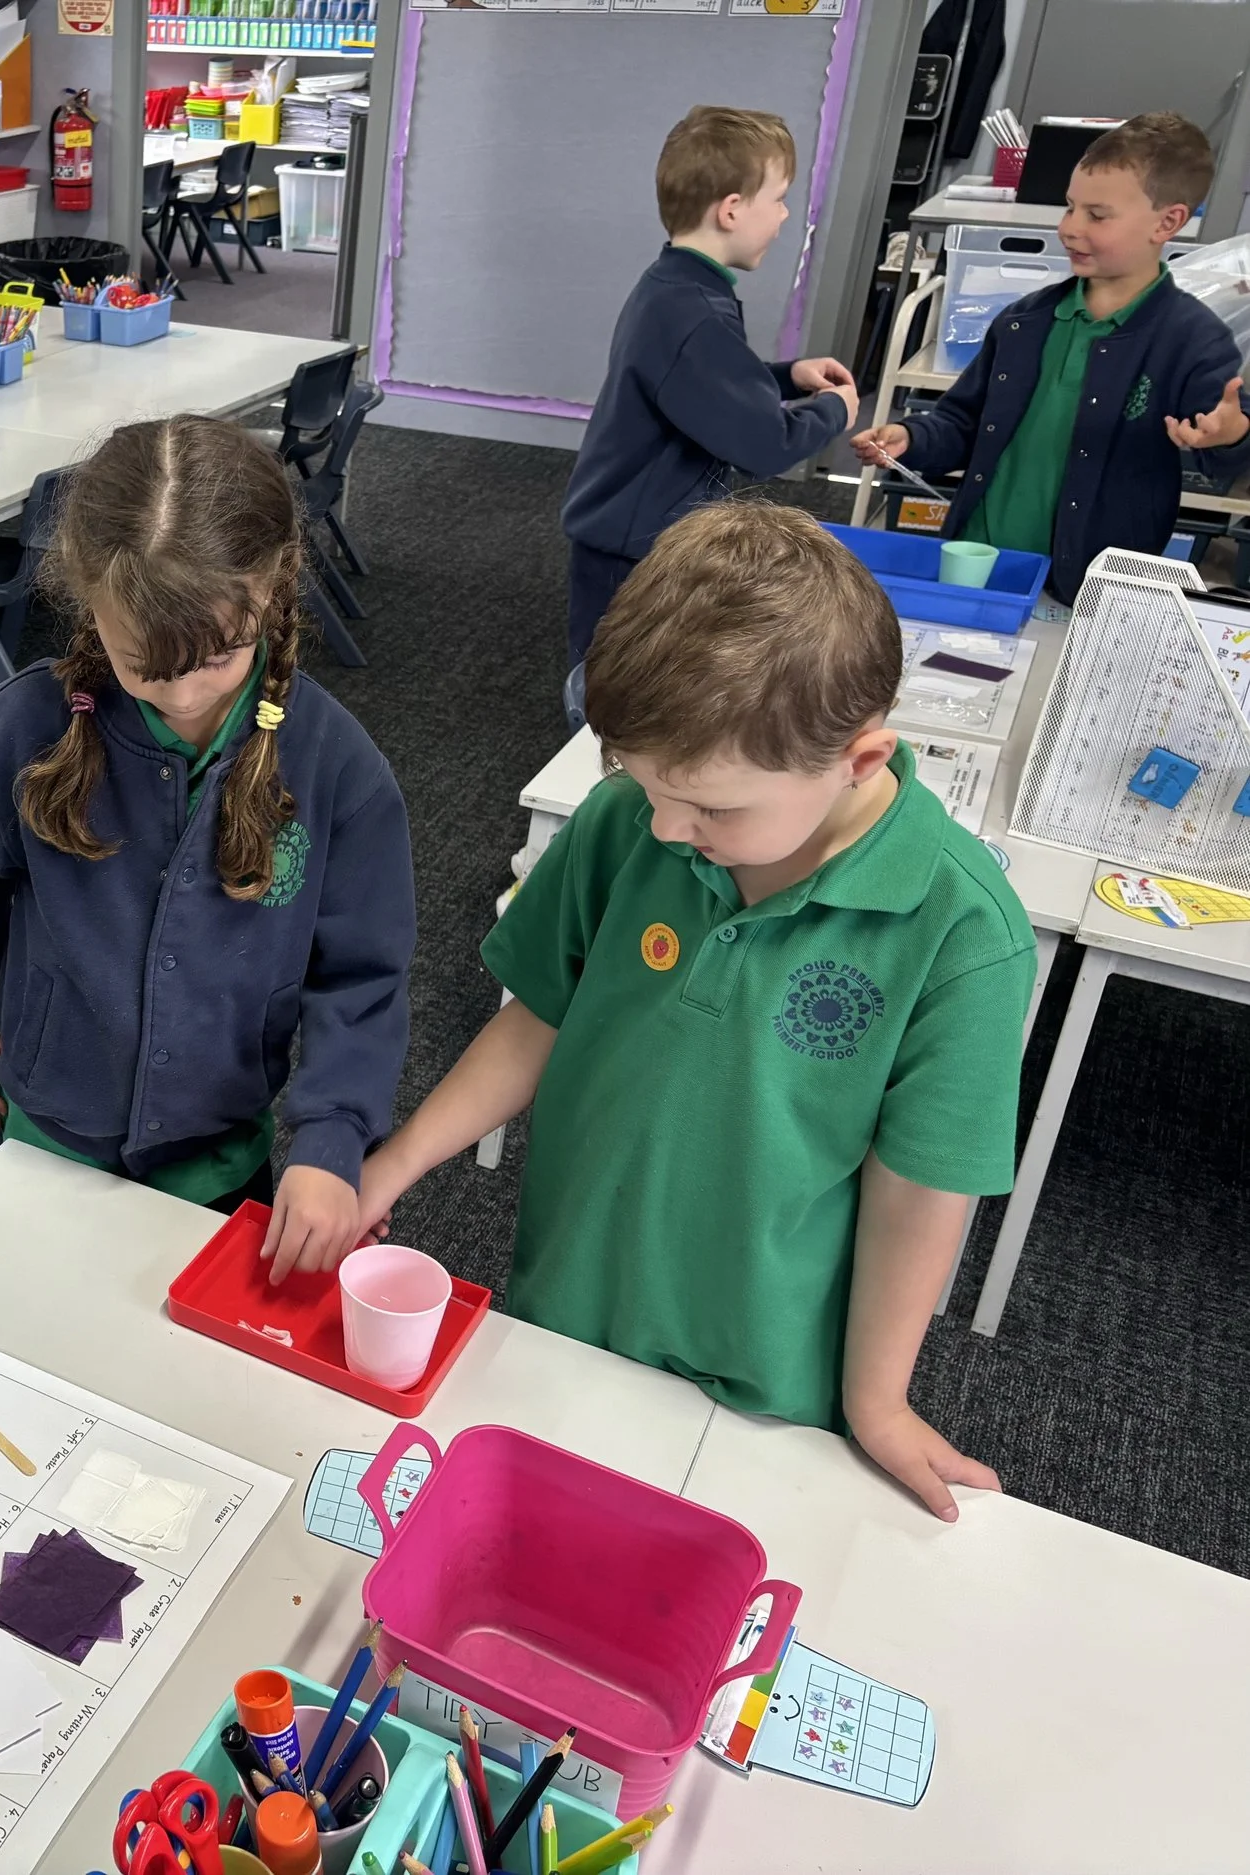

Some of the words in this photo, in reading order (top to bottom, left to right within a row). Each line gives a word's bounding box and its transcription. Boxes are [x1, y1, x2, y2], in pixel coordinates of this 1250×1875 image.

[787, 960, 836, 983] APOLLO
[809, 1045, 860, 1061] SCHOOL
[81, 1417, 95, 1426] 5.
[67, 1429, 85, 1446] Soft
[45, 1446, 69, 1471] Plastic
[7, 1504, 22, 1514] 6.
[167, 1577, 182, 1588] 2.
[129, 1621, 152, 1649] Paper
[91, 1687, 107, 1698] 3.
[415, 1680, 503, 1740] TIDY
[58, 1704, 96, 1741] Writing
[4, 1807, 20, 1818] 4.
